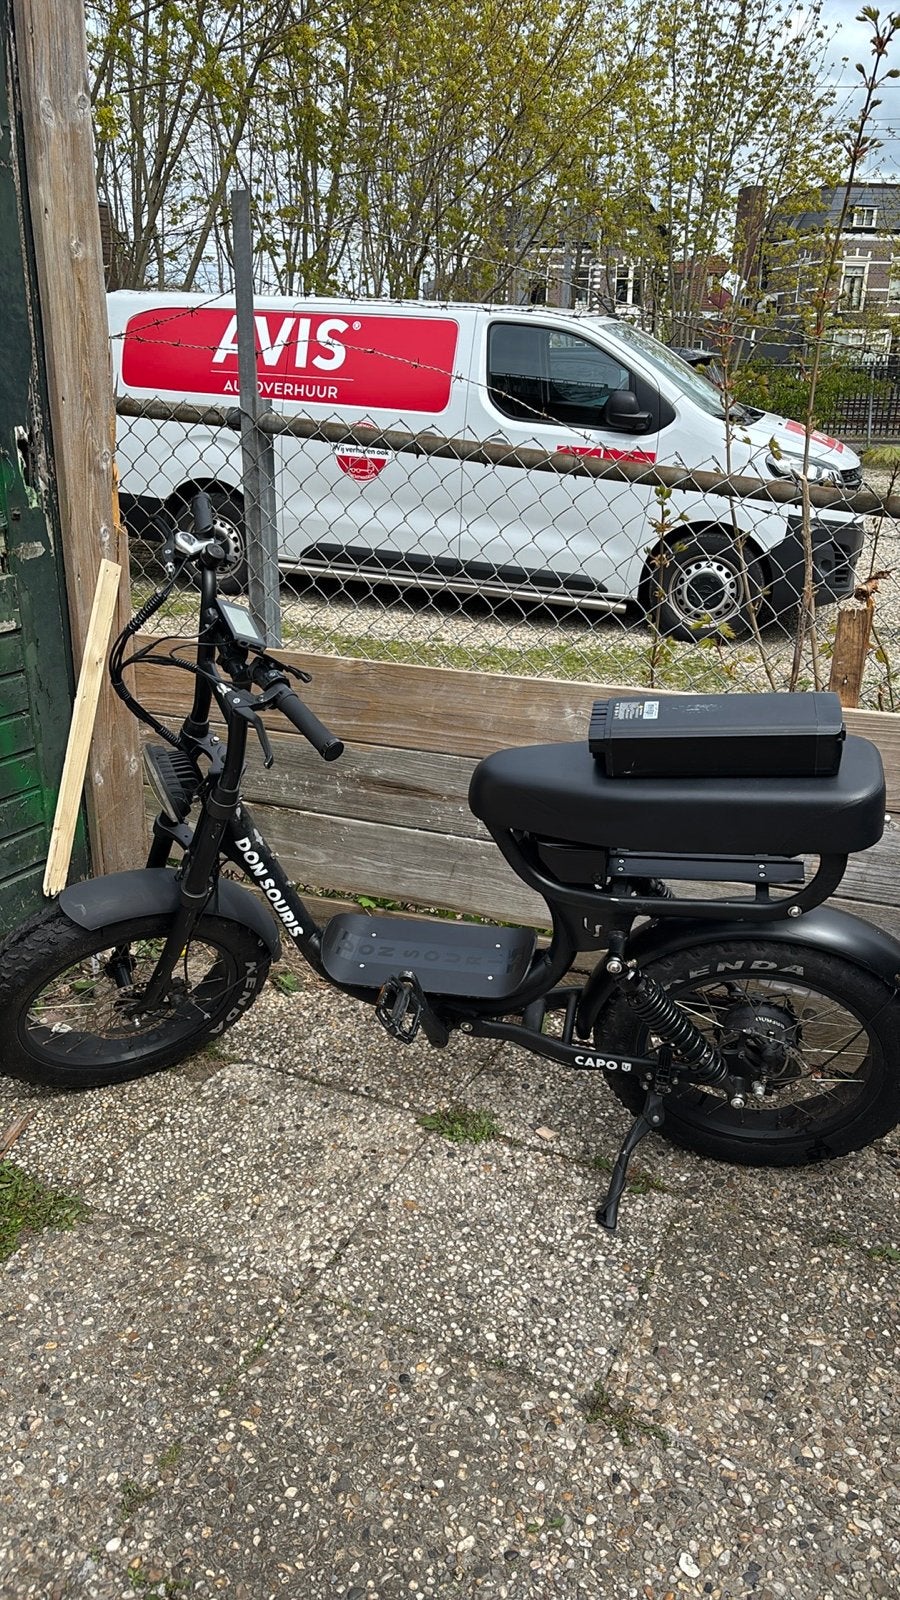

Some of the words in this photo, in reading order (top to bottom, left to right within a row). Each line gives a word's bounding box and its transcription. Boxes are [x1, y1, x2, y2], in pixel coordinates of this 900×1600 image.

[223, 380, 338, 399] AUOVERHUUR
[345, 445, 376, 455] verhuen
[376, 448, 390, 456] ook
[235, 837, 269, 877] DON
[260, 878, 304, 937] SOURIS
[209, 962, 258, 1034] KENDA
[574, 1055, 618, 1070] CAPO
